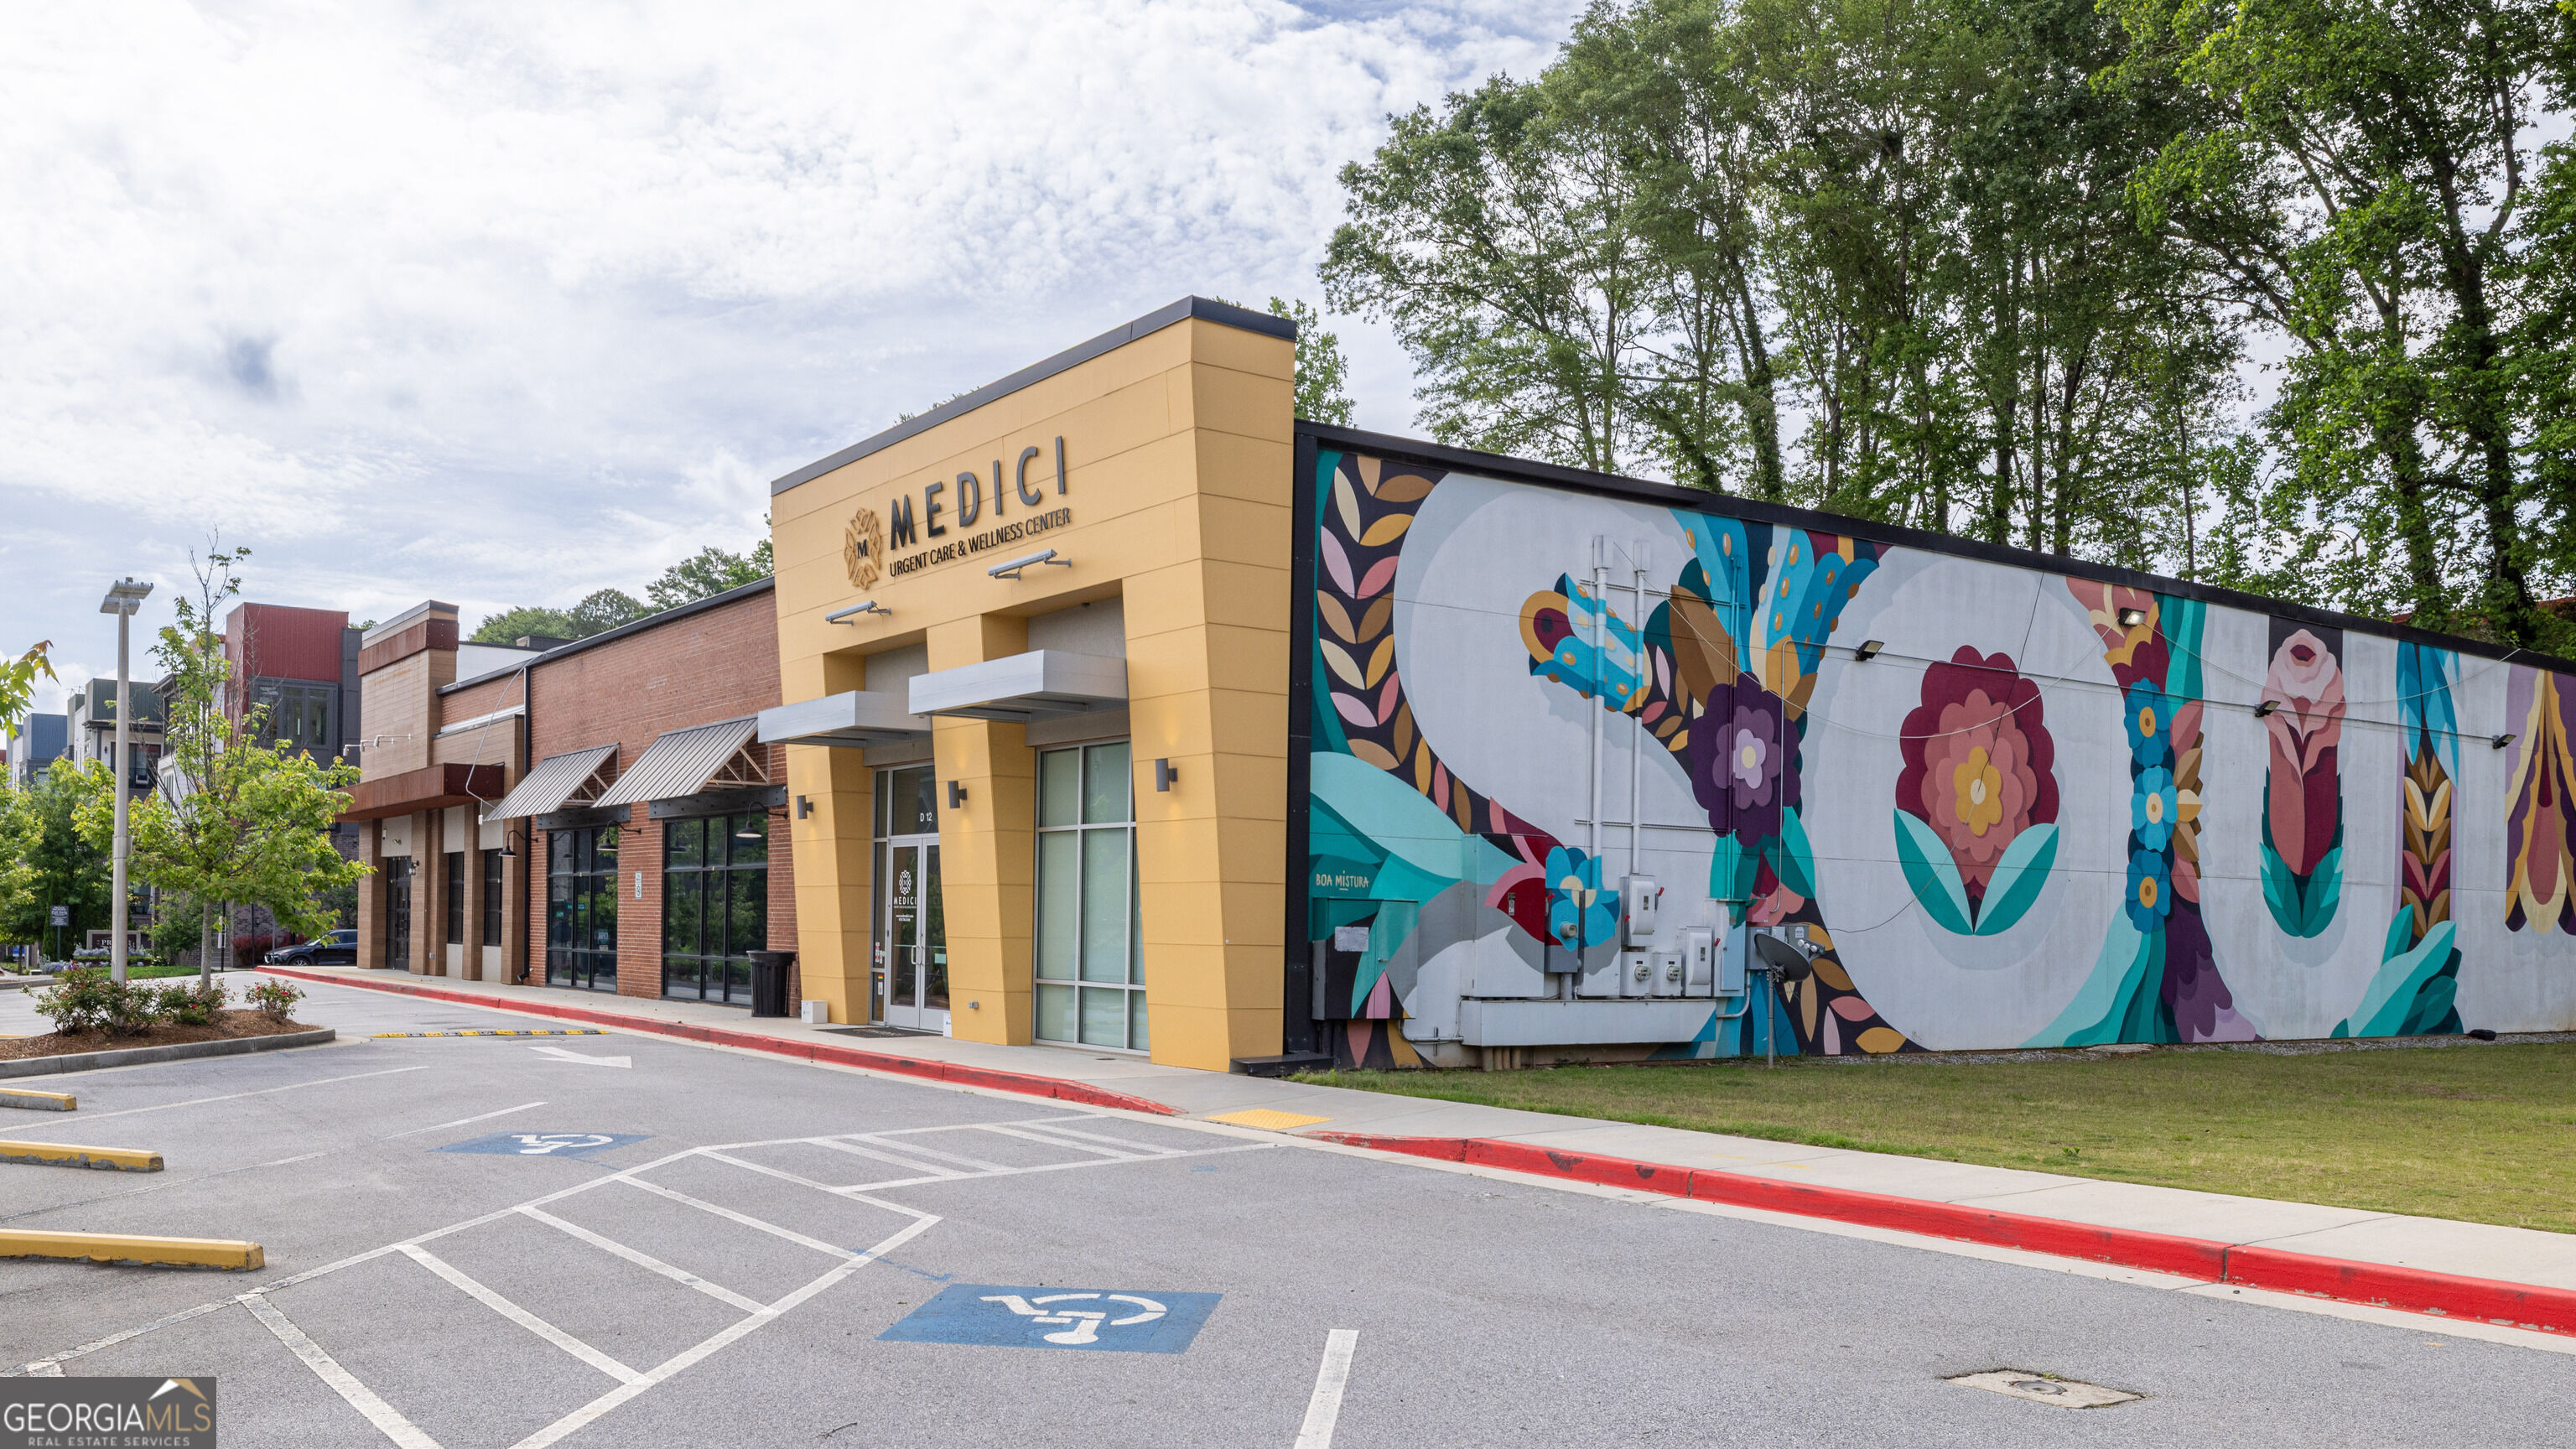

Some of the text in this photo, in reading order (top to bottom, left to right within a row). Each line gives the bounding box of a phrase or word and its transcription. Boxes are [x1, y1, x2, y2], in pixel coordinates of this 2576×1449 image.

[891, 436, 1066, 550] MEDICI
[857, 538, 869, 559] M
[890, 506, 1071, 577] URGENT CARE & WELLNESS CENTER
[920, 812, 932, 822] D 12
[1316, 874, 1332, 886] BOA
[893, 896, 917, 906] MEDICI
